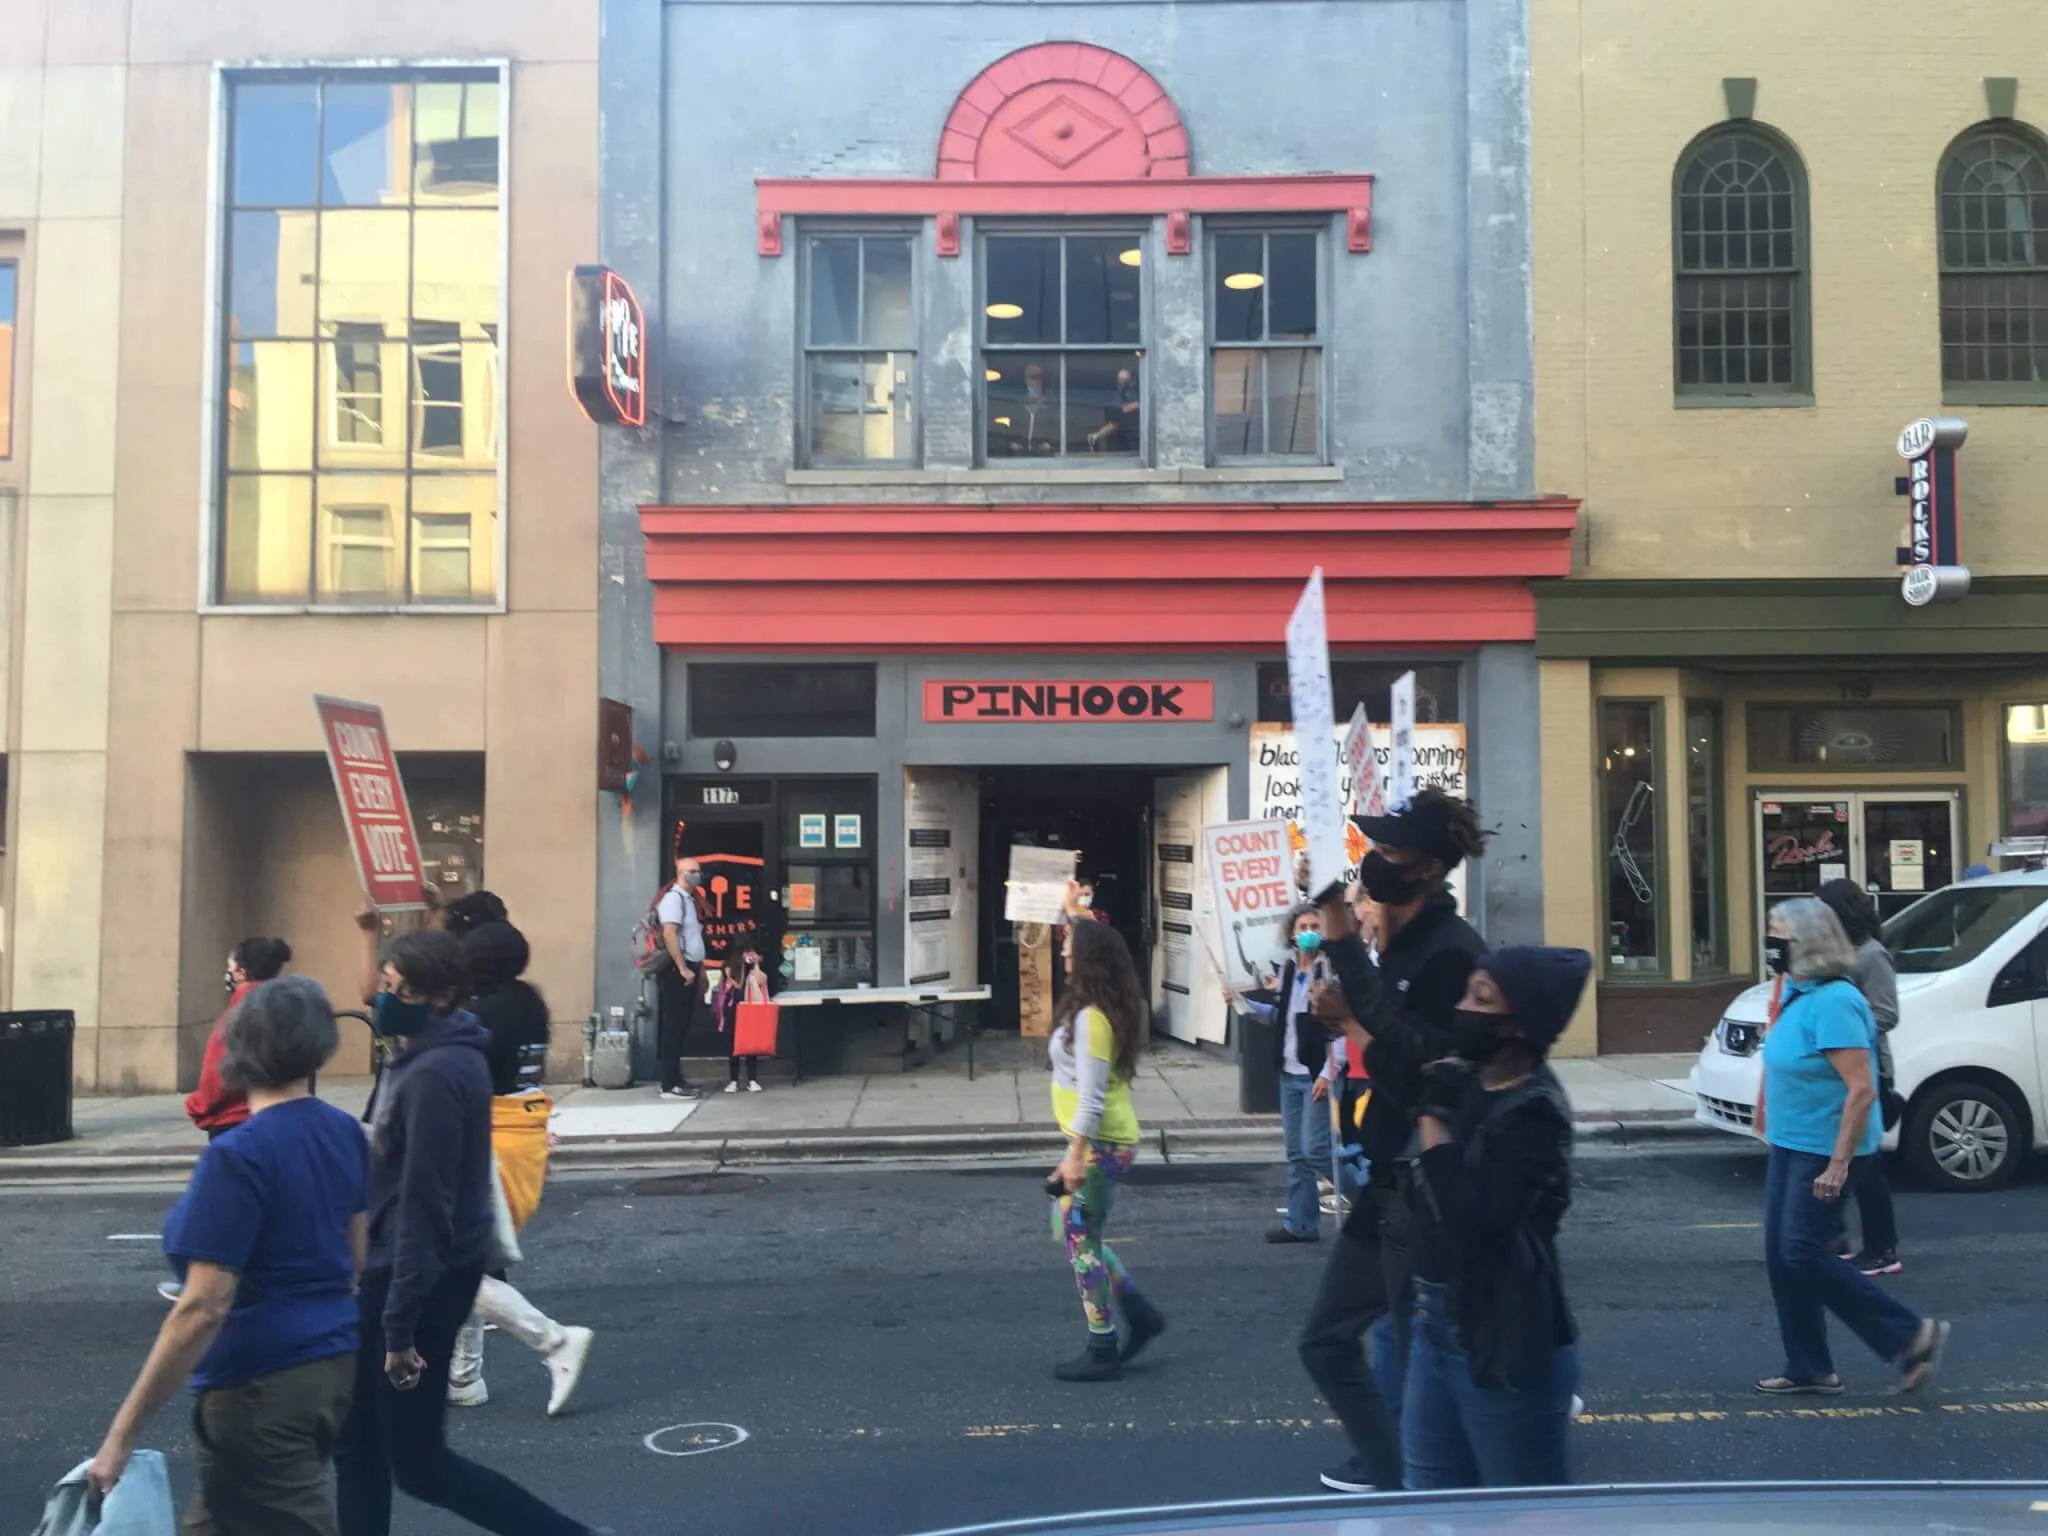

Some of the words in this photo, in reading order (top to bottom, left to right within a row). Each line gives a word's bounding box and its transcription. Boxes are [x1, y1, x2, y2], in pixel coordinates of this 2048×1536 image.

[1911, 460, 1930, 561] ROCKS
[942, 685, 1184, 716] PINHOOK
[333, 721, 384, 761] COUNT
[1259, 743, 1303, 767] blac
[347, 772, 397, 810] EVERY
[360, 824, 415, 871] VOTE
[1215, 830, 1280, 856] COUNT
[1221, 855, 1281, 883] EVERY
[1225, 880, 1290, 913] VOTE
